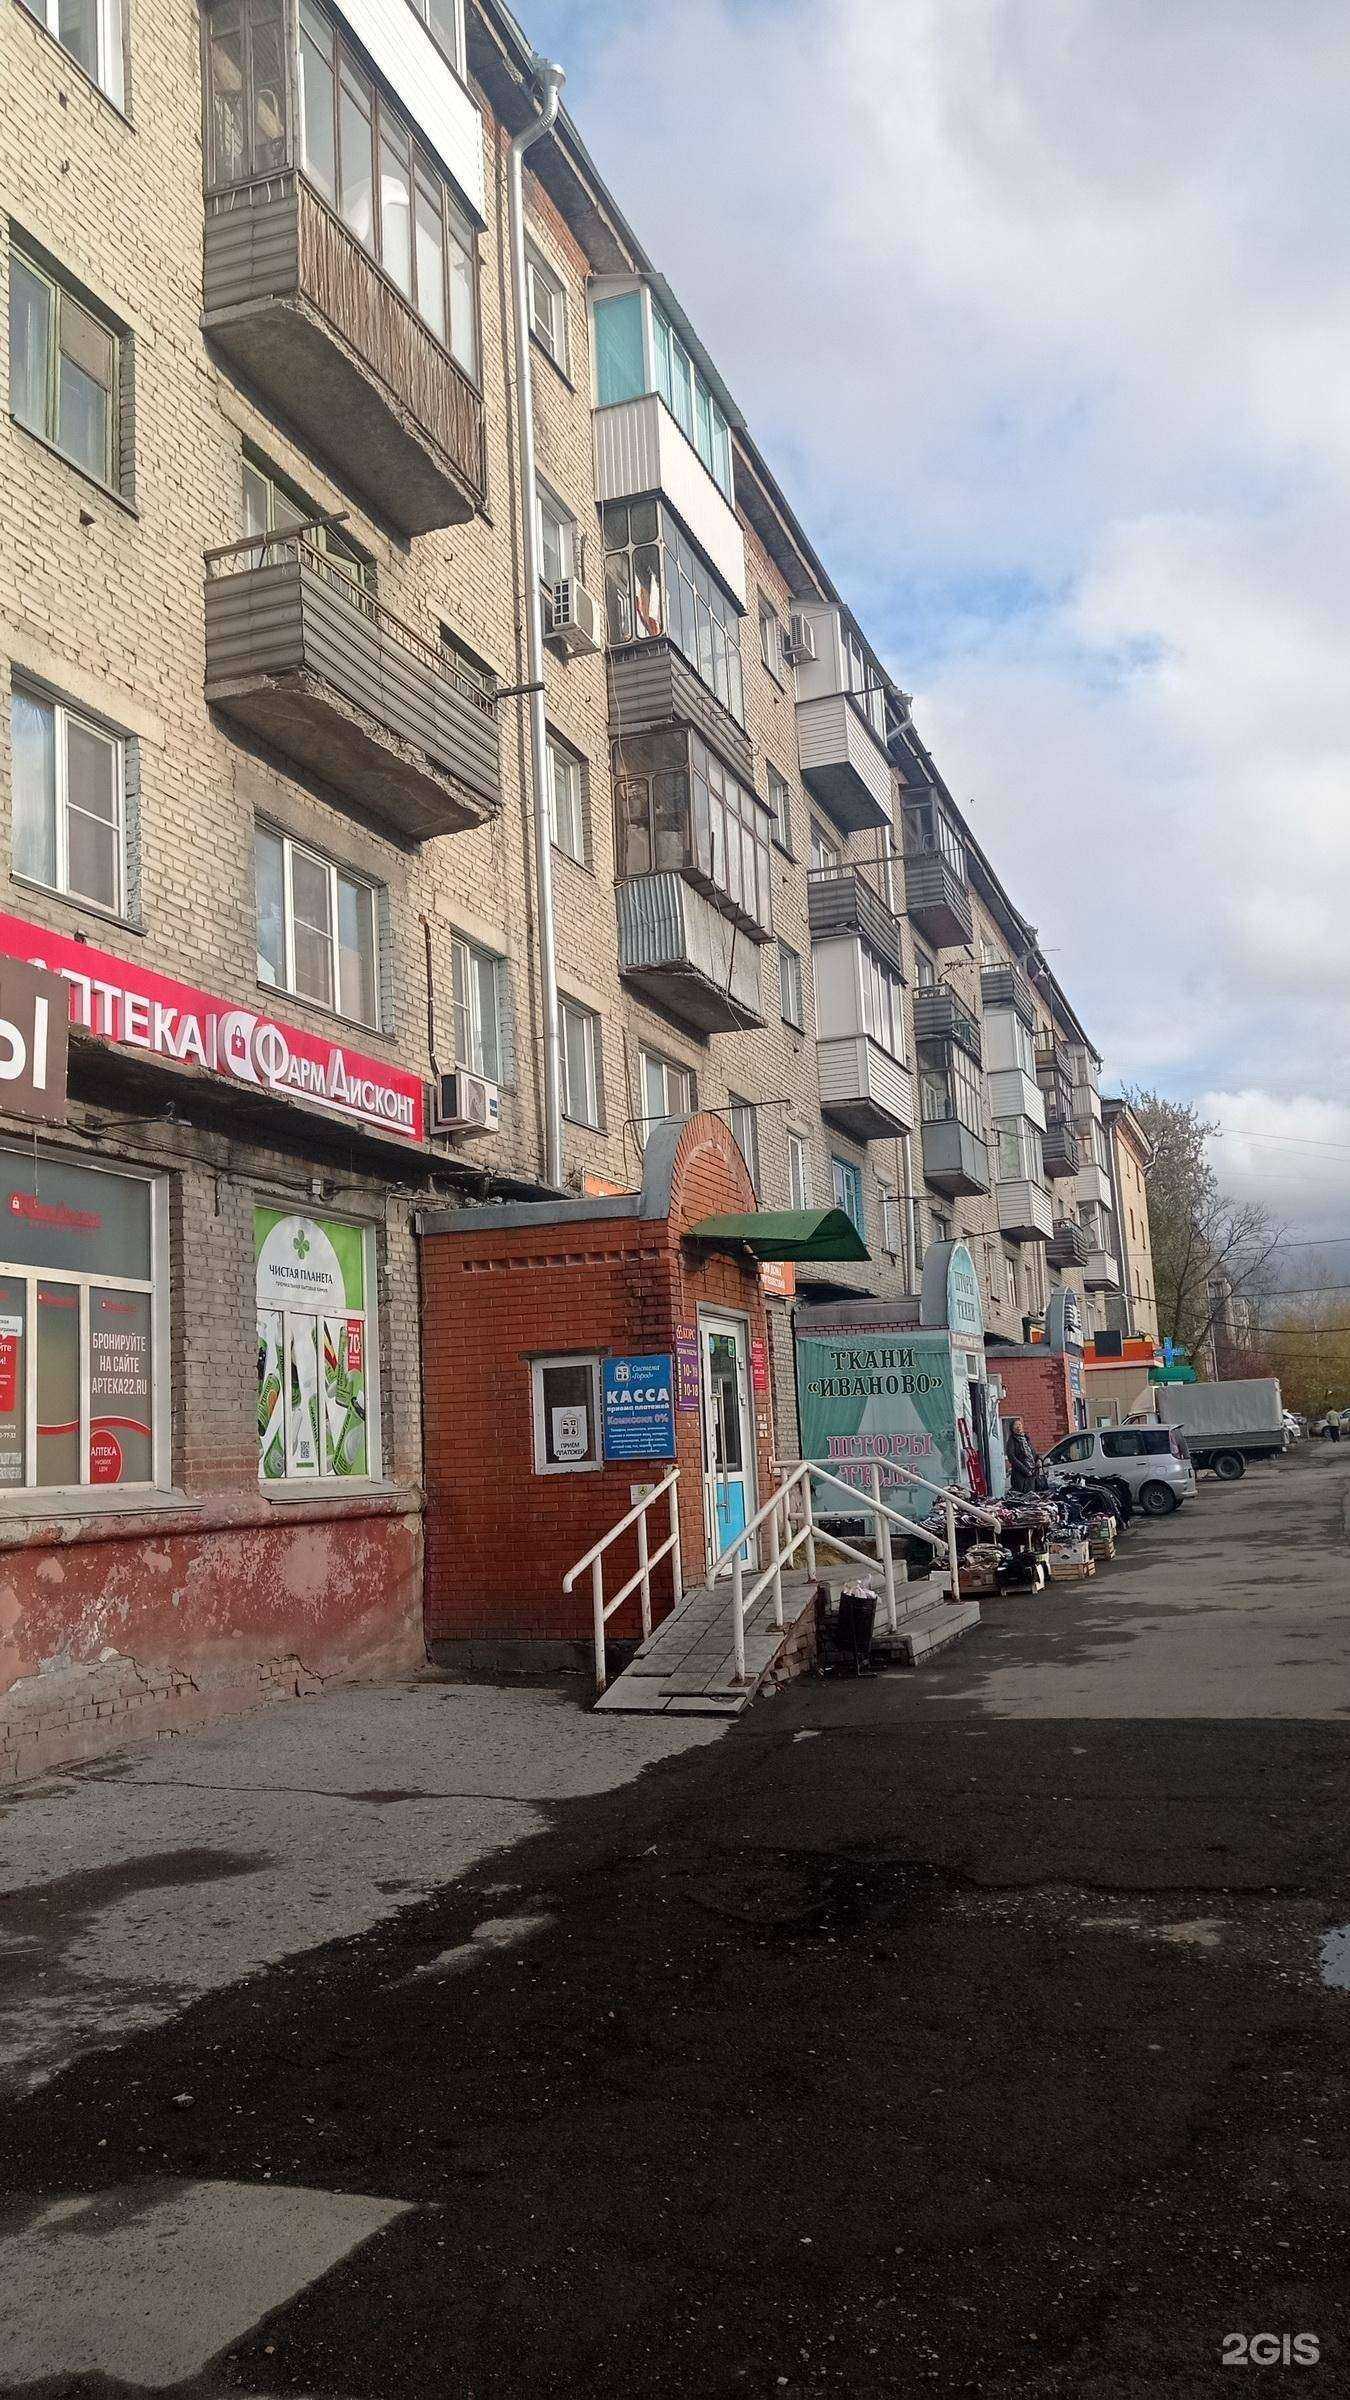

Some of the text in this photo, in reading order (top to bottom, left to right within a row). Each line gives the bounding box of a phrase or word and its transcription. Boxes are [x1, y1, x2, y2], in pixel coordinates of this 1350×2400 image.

[26, 957, 208, 1068] ПТЕКА
[268, 1264, 334, 1285] ЧИСТАЯ ПЛАНЕТА
[92, 1332, 146, 1352] БРОНИРУЙТЕ
[99, 1353, 140, 1373] НА САЙТЕ
[830, 1347, 916, 1371] ТКАНИ
[91, 1377, 148, 1395] APTEKA22.RU
[606, 1387, 670, 1404] КАССА
[807, 1374, 943, 1397] «ИВАНОВО»
[91, 1446, 118, 1456] АПТЕКА
[826, 1432, 933, 1459] ШТОРЫ
